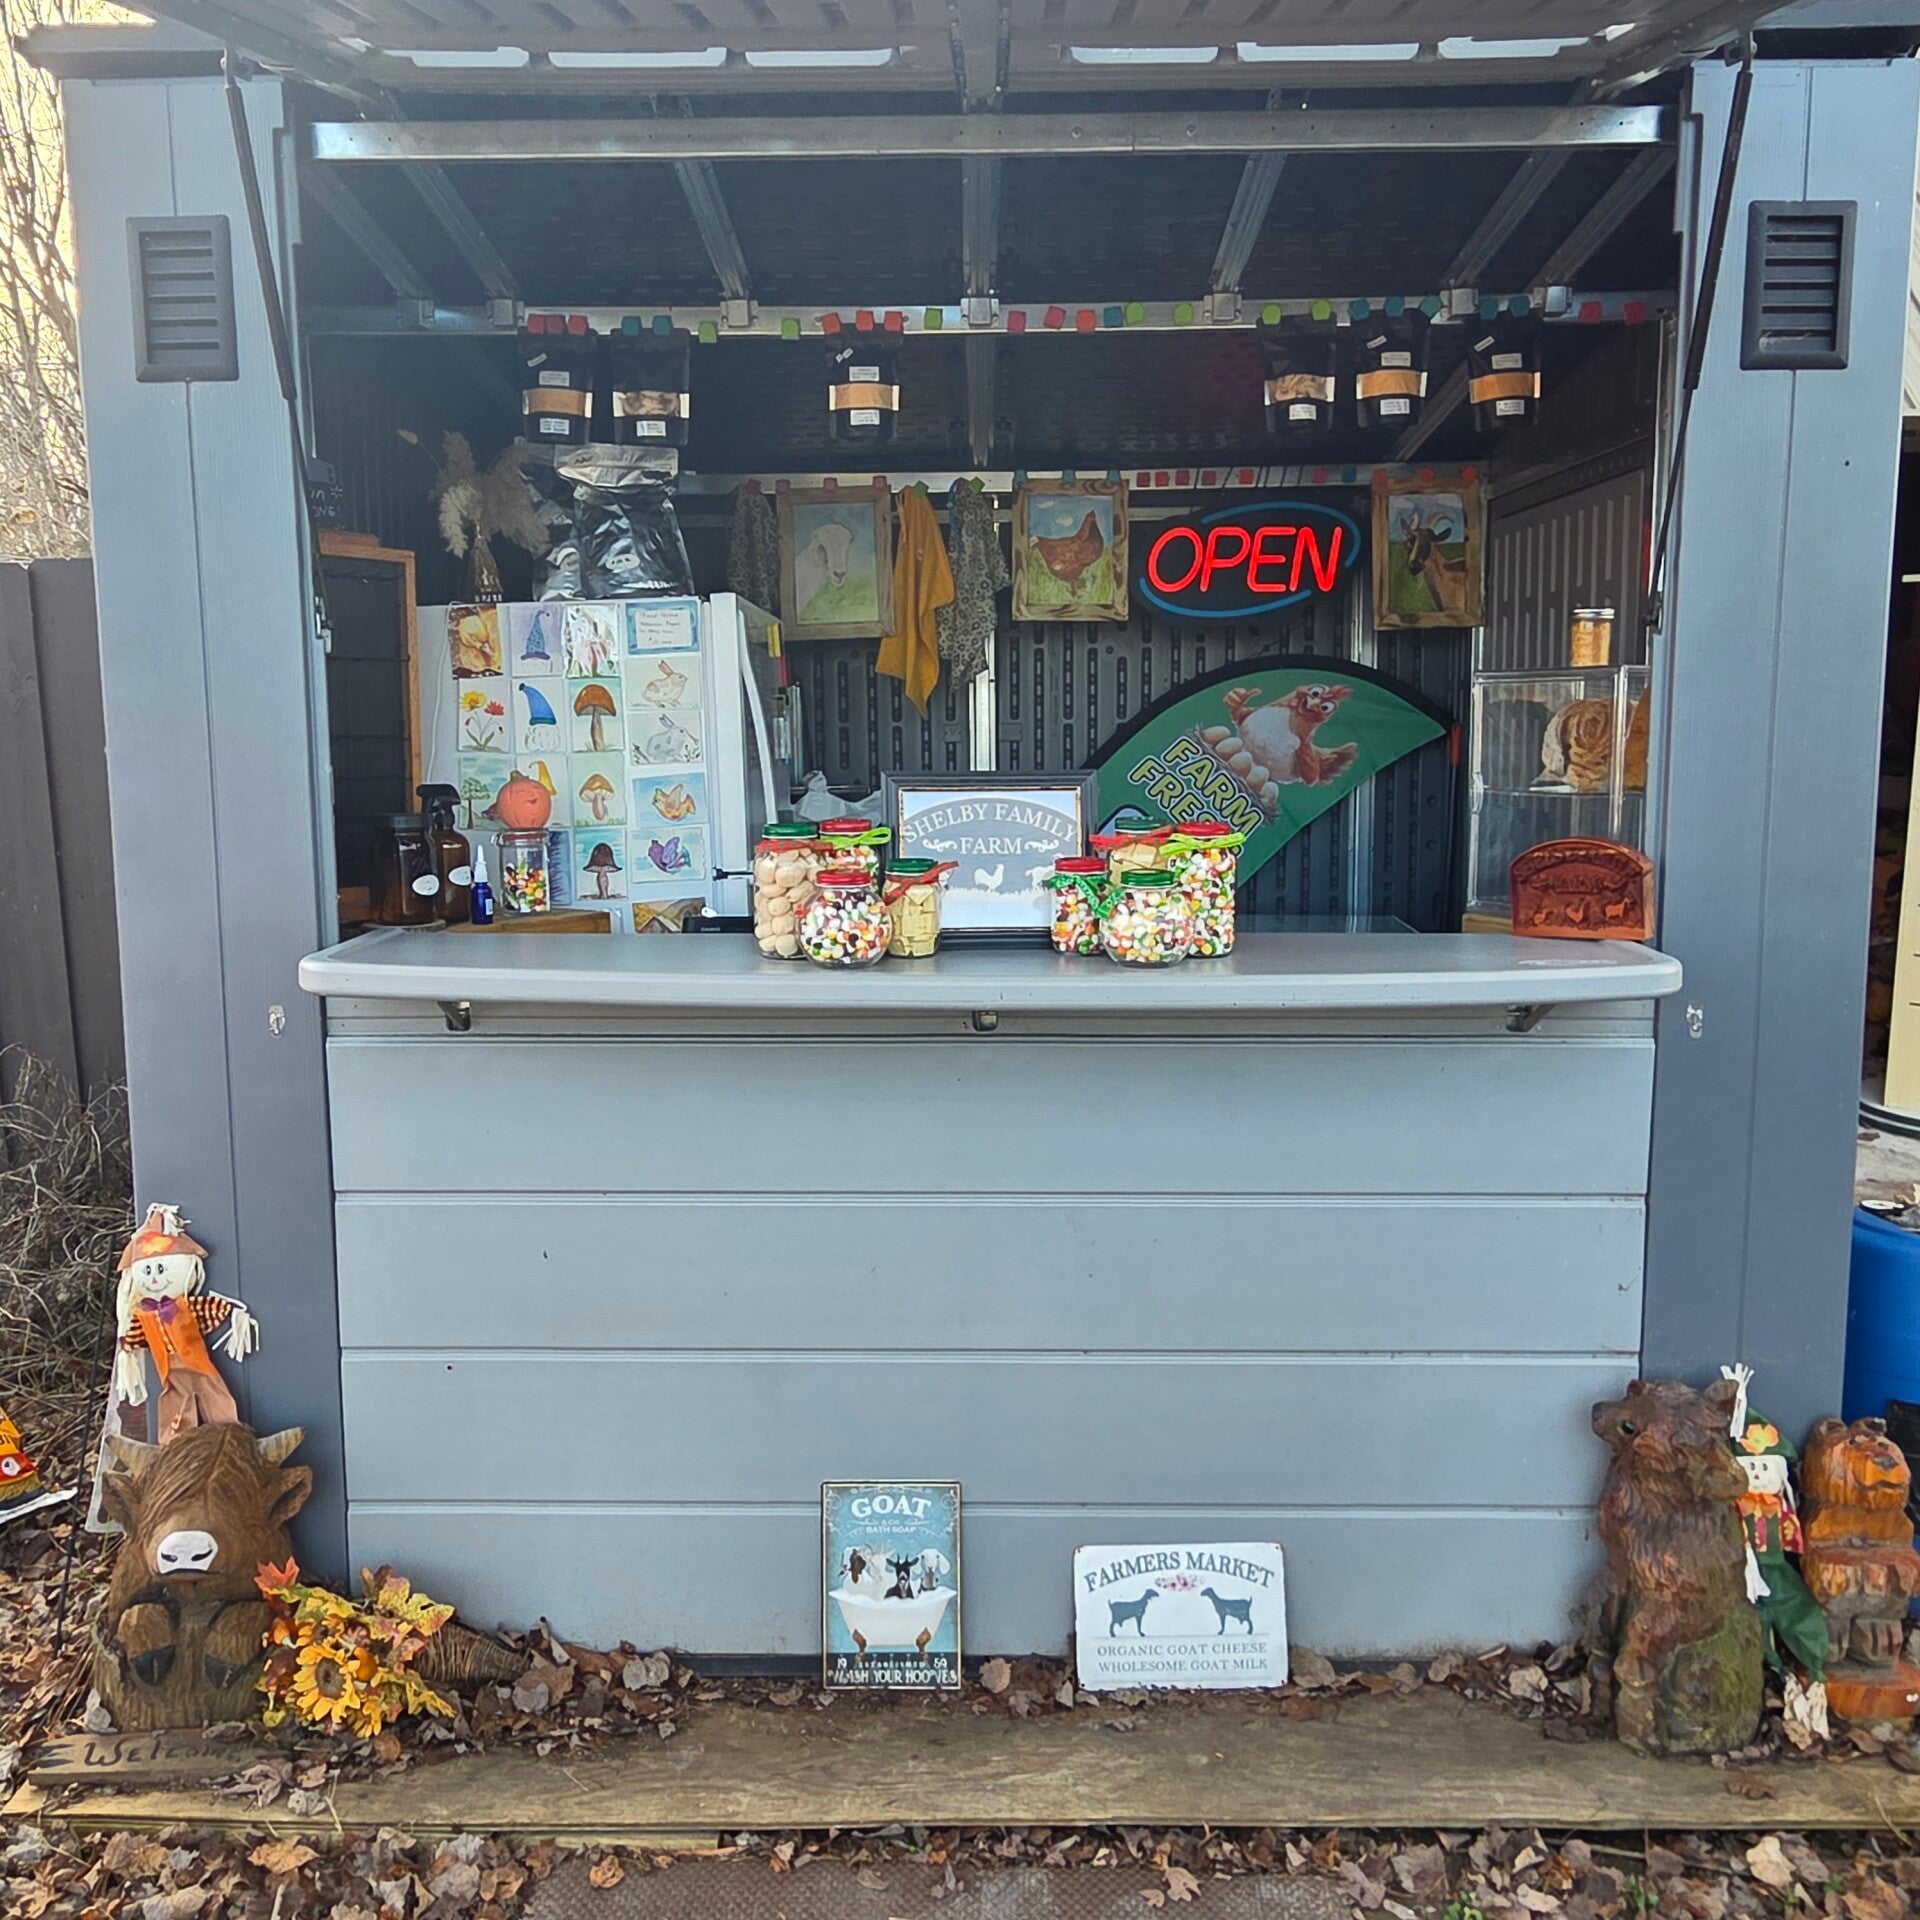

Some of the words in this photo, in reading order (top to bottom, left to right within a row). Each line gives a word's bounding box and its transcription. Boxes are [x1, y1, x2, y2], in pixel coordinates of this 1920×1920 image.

[1147, 526, 1343, 593] OPEN
[1163, 737, 1263, 838] FARM
[904, 803, 988, 844] SHELBY
[995, 803, 1076, 843] FAMILY
[959, 837, 1022, 855] FARM
[851, 1495, 932, 1519] GOAT
[1084, 1551, 1181, 1593] FARMERS
[1187, 1551, 1275, 1588] MARKET
[1097, 1644, 1163, 1657] ORGANIC
[1167, 1643, 1207, 1656] GOAT
[1212, 1642, 1267, 1655] CHEESE
[838, 1658, 847, 1669] 19
[1098, 1659, 1187, 1673] WHOLESOME
[1190, 1659, 1229, 1672] GOAT
[1233, 1658, 1268, 1670] MILK
[828, 1669, 869, 1683] WASH
[873, 1670, 903, 1683] YOUR
[906, 1669, 958, 1683] HOOVES
